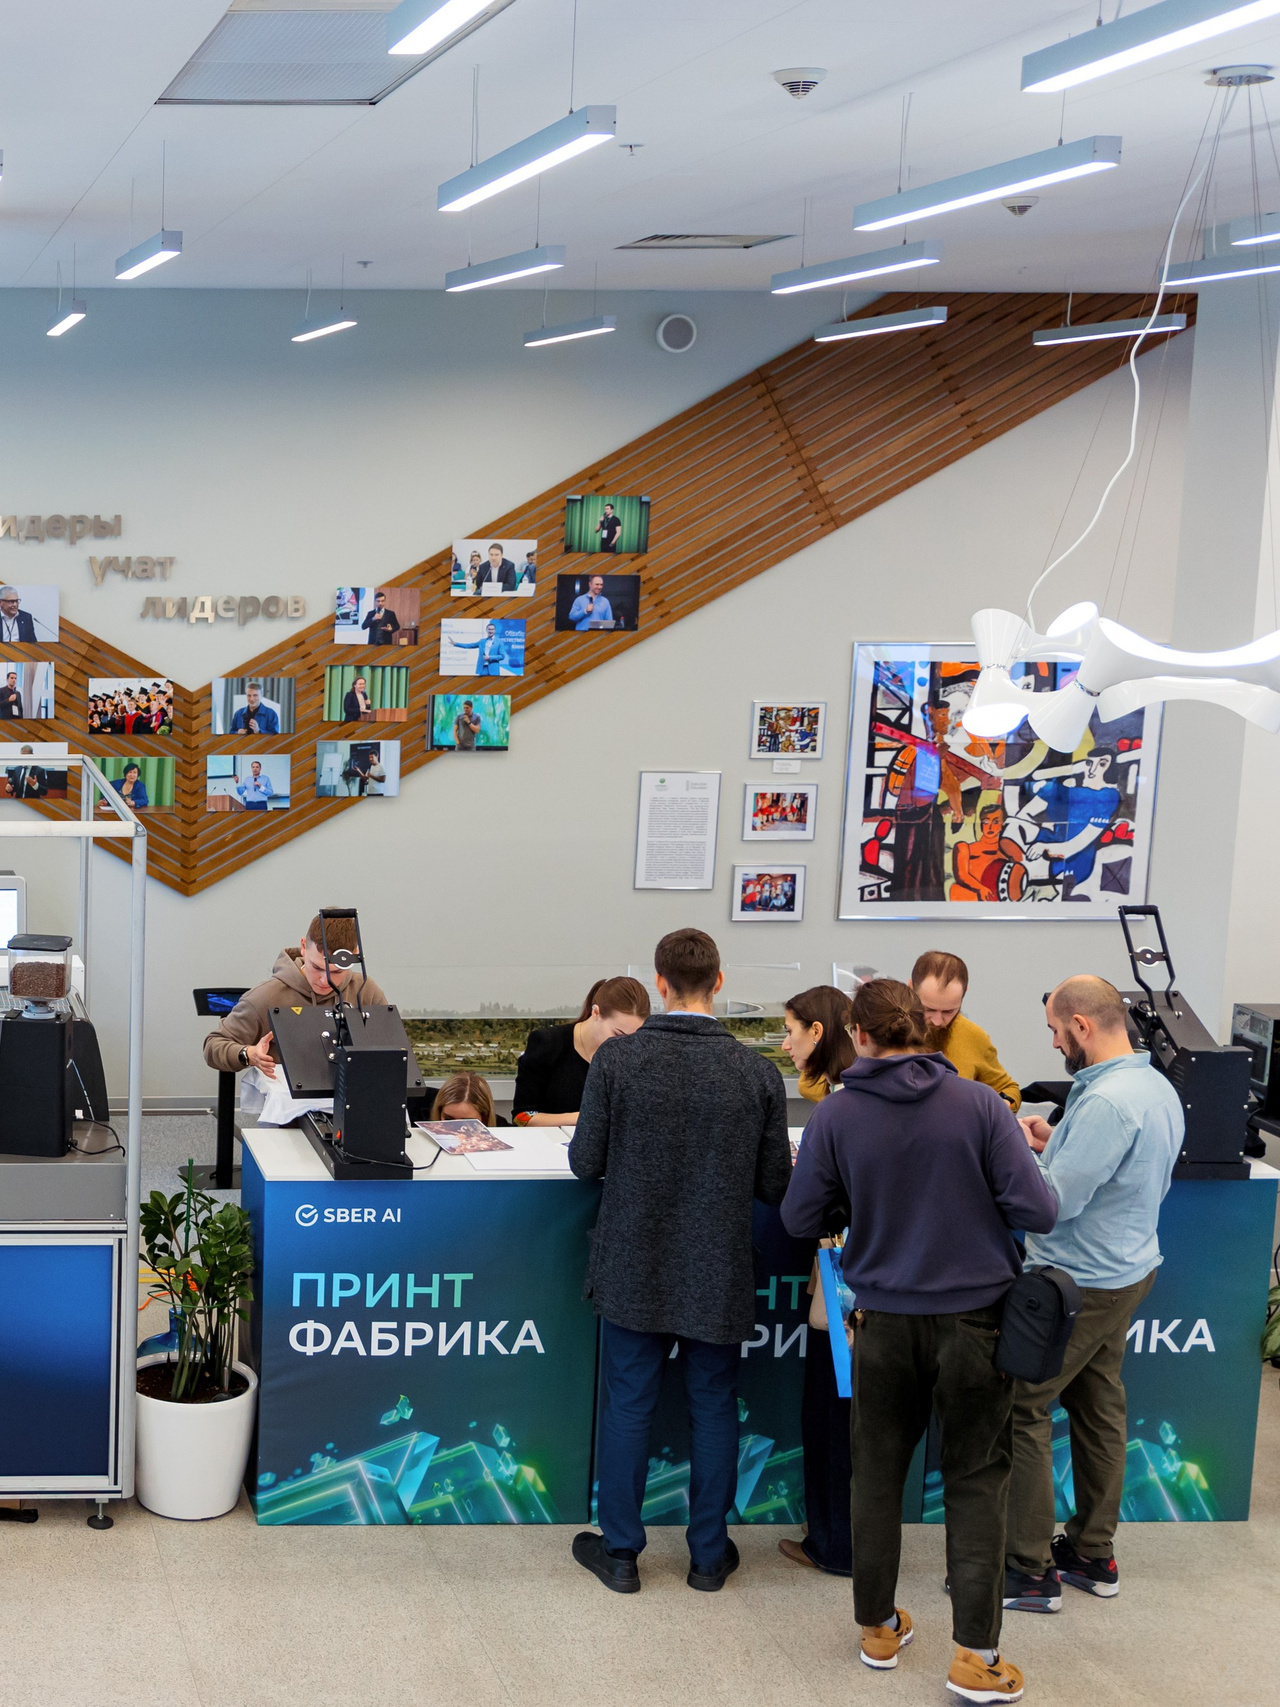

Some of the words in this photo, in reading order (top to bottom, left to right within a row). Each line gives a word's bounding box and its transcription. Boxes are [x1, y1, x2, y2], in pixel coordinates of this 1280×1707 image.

[89, 555, 176, 586] учат
[140, 595, 306, 626] лидеров
[323, 1208, 376, 1223] SBER
[381, 1208, 401, 1223] AI
[292, 1272, 474, 1308] ПРИНТ
[288, 1320, 545, 1356] ФАБРИКА
